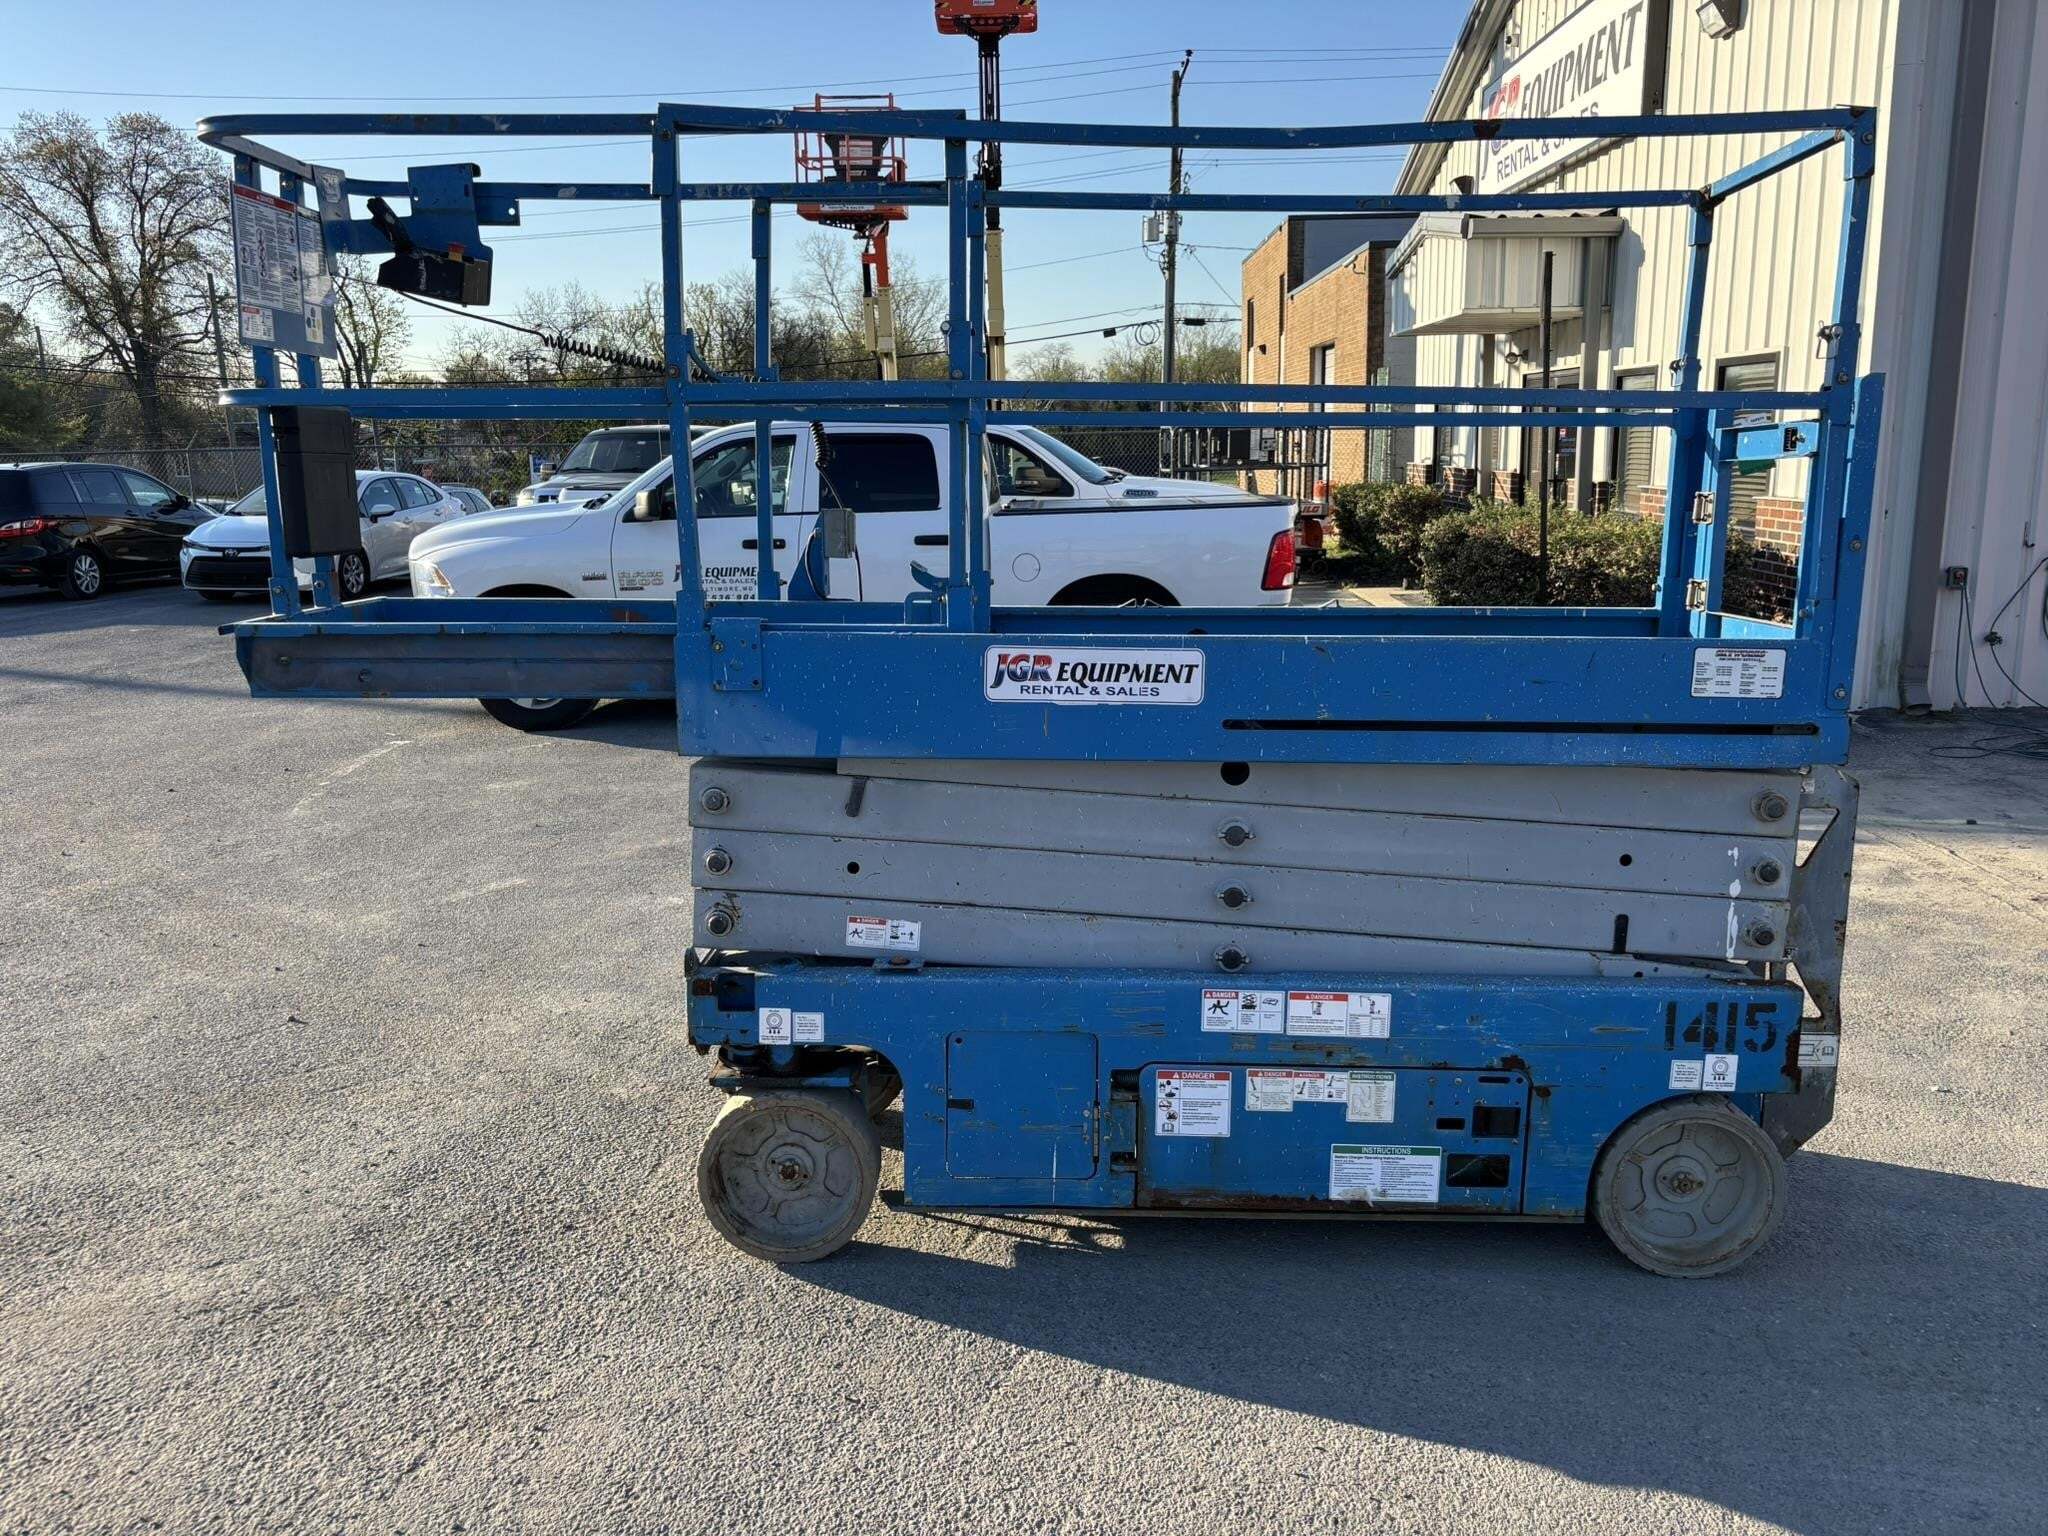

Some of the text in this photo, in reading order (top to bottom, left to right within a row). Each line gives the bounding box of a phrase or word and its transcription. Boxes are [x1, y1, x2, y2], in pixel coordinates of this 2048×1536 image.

[1521, 4, 1643, 119] EQUIPMENT
[1497, 138, 1538, 182] RENTAL
[705, 567, 757, 581] EQUIPME
[990, 653, 1199, 689] JGR EQUIPMENT
[1020, 685, 1160, 697] RENTAL & SALES
[1664, 1002, 1777, 1054] 1415
[1361, 1146, 1412, 1155] INSTRUCTIONS
